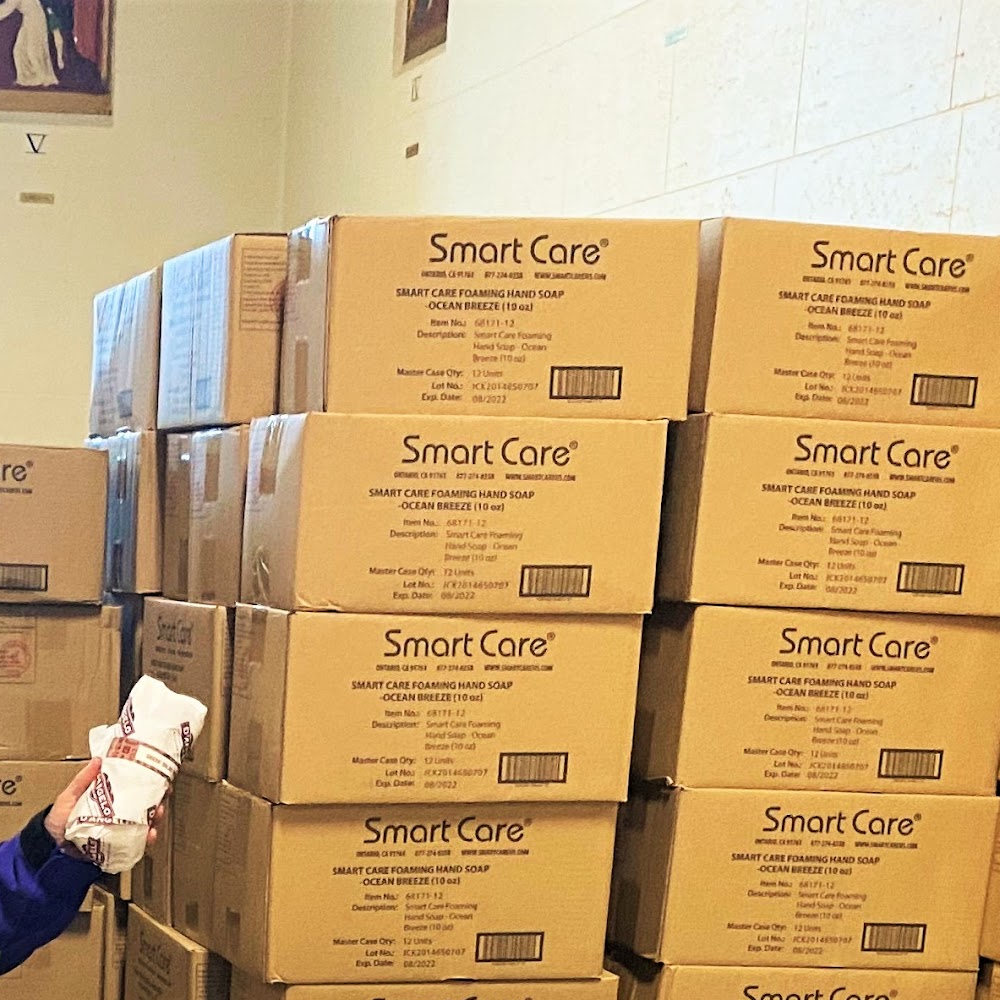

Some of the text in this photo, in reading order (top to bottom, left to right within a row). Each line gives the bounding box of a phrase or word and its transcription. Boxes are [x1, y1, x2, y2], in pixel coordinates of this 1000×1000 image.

[25, 133, 48, 154] V
[429, 233, 523, 264] Smart
[811, 240, 897, 274] Smart
[396, 288, 564, 298] SMART CARE FOAMING HAND SOAP
[465, 302, 499, 310] BREEZE
[401, 435, 494, 465] Smart
[794, 434, 881, 466] Smart
[369, 489, 535, 499] SMART CARE FOAMING HAND SOAP
[437, 502, 472, 511] BREEZE
[383, 629, 473, 657] Smart
[779, 628, 863, 657] Smart
[351, 681, 513, 690] SMART CARE FOAMING HAND SOAP
[418, 693, 451, 702] BREEZE
[363, 817, 450, 844] Smart
[762, 806, 847, 834] Smart
[333, 864, 490, 875] SMART CARE FOAMING HAND SOAP
[397, 877, 429, 886] BREEZE
